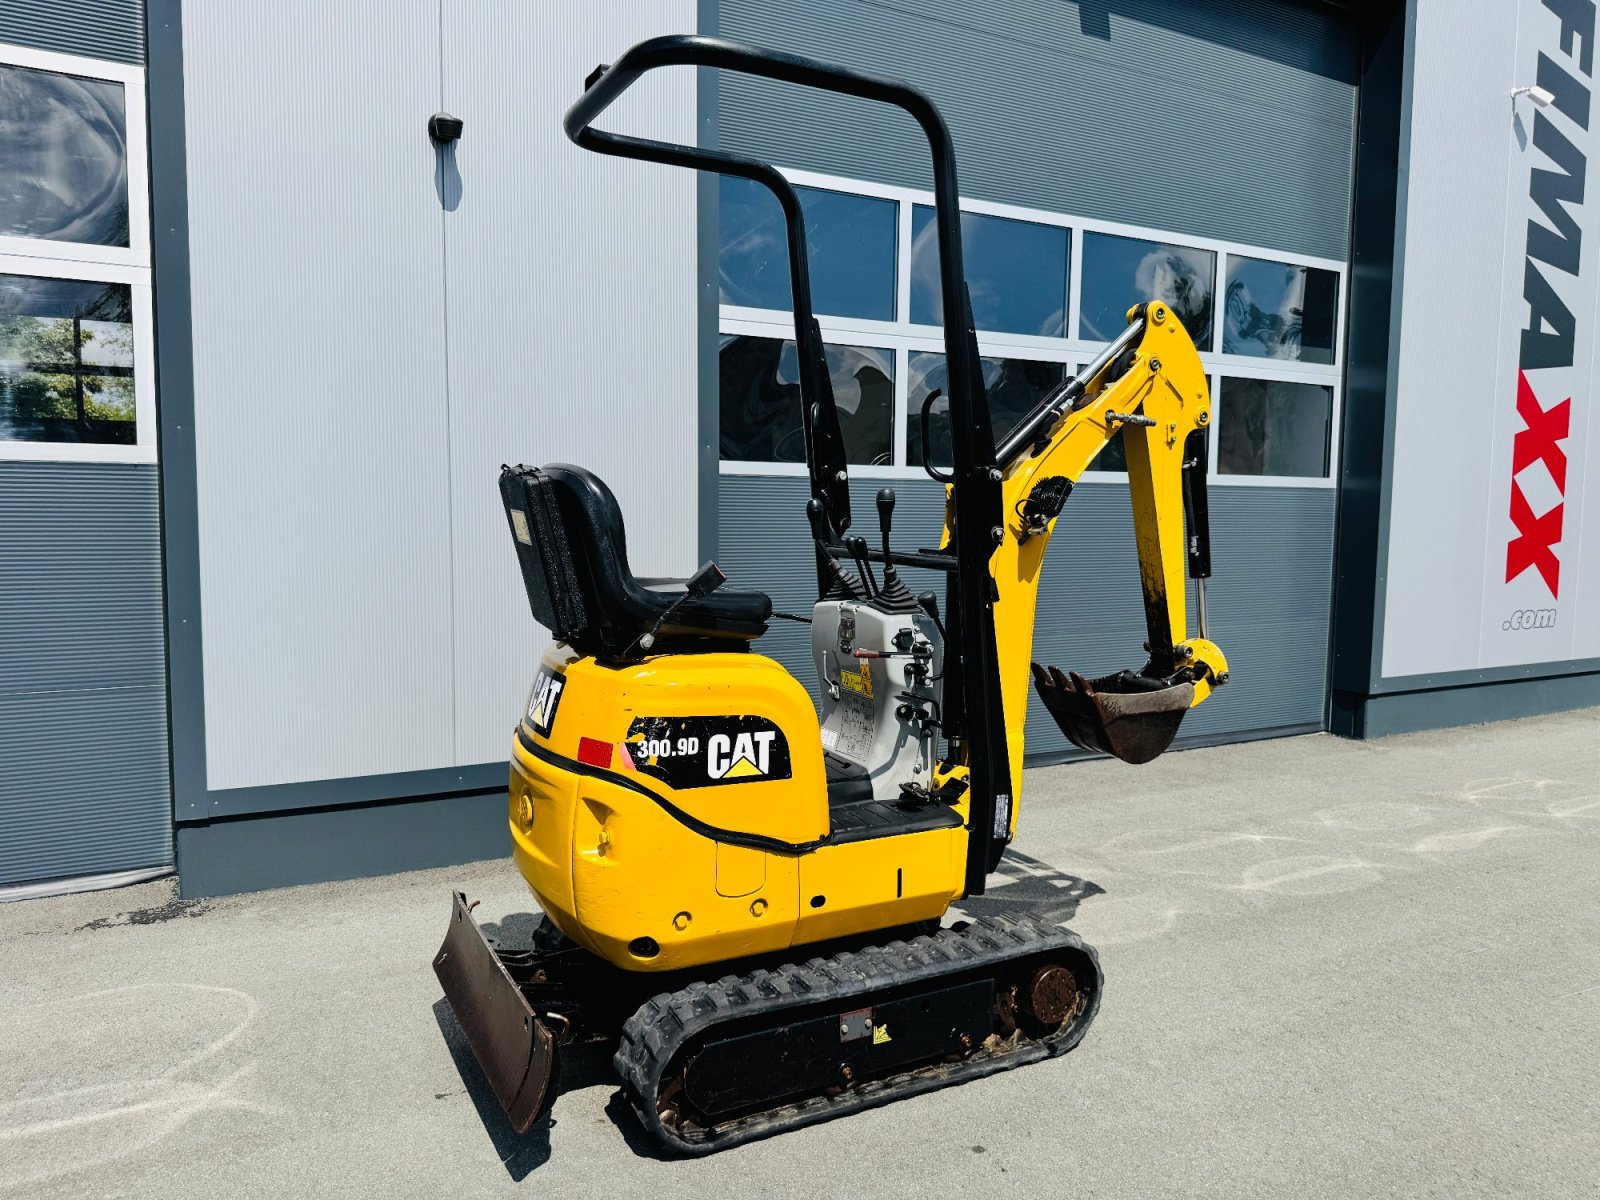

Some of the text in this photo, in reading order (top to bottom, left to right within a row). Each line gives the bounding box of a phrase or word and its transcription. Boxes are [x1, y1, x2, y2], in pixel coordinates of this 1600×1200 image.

[1502, 609, 1557, 631] .com
[528, 671, 563, 729] CAT
[637, 731, 775, 779] 300.9D CAT
